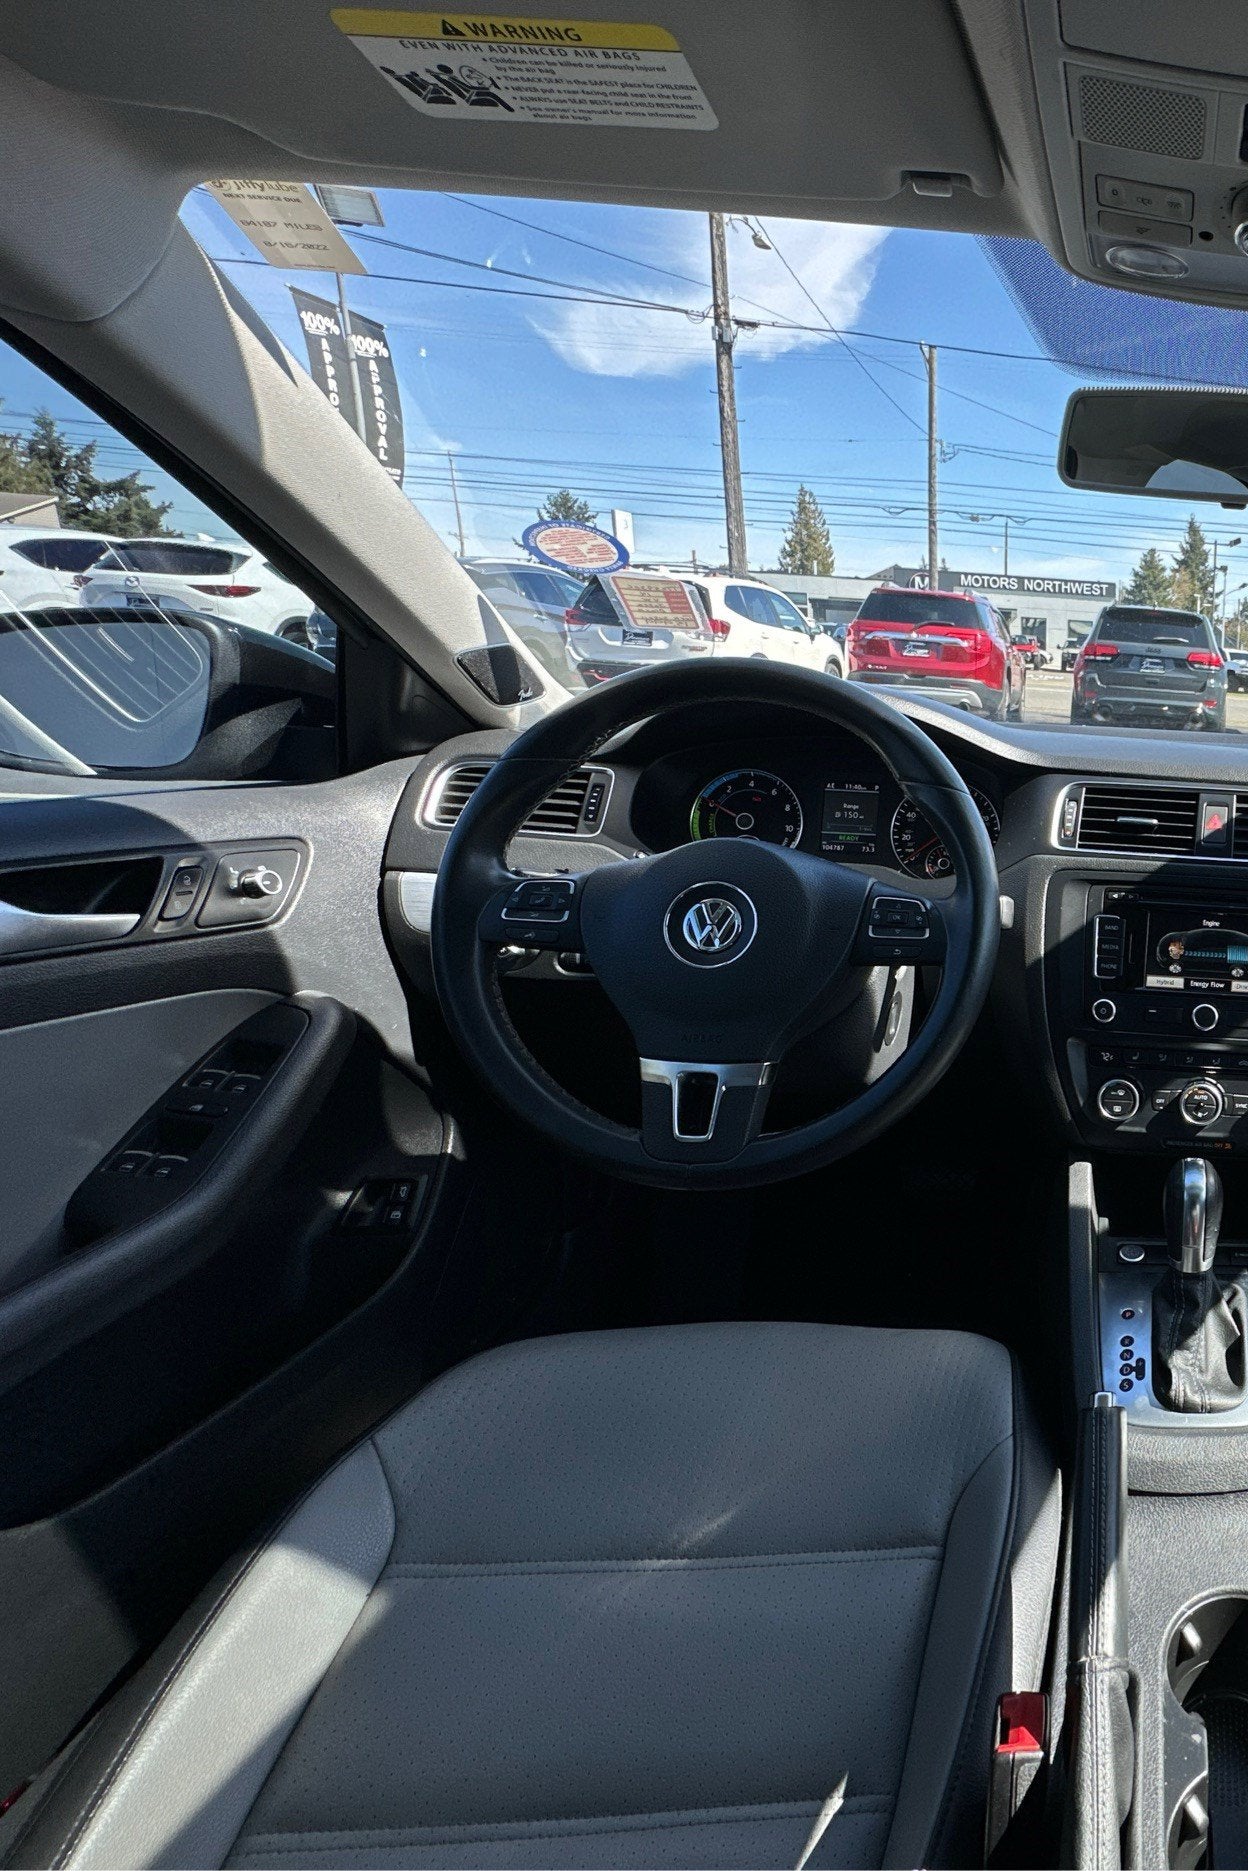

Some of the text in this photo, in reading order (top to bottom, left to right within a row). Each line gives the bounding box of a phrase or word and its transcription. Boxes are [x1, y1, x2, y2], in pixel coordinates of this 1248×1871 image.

[463, 21, 582, 42] WARNING
[399, 39, 641, 60] EVEN WITH ADVANCED AIR BAGS
[284, 222, 323, 231] MILES
[300, 310, 340, 336] 100%
[351, 334, 389, 358] 100%
[321, 337, 340, 411] APPRO
[368, 359, 388, 461] APPROVAL
[960, 574, 1108, 596] MOTORS NORTHWEST
[771, 788, 777, 796] 6
[844, 811, 859, 819] 150
[906, 811, 917, 819] 40
[785, 824, 794, 832] 10
[1202, 919, 1220, 928] Engine
[1156, 979, 1175, 987] Hybrid
[1190, 980, 1210, 989] Energy
